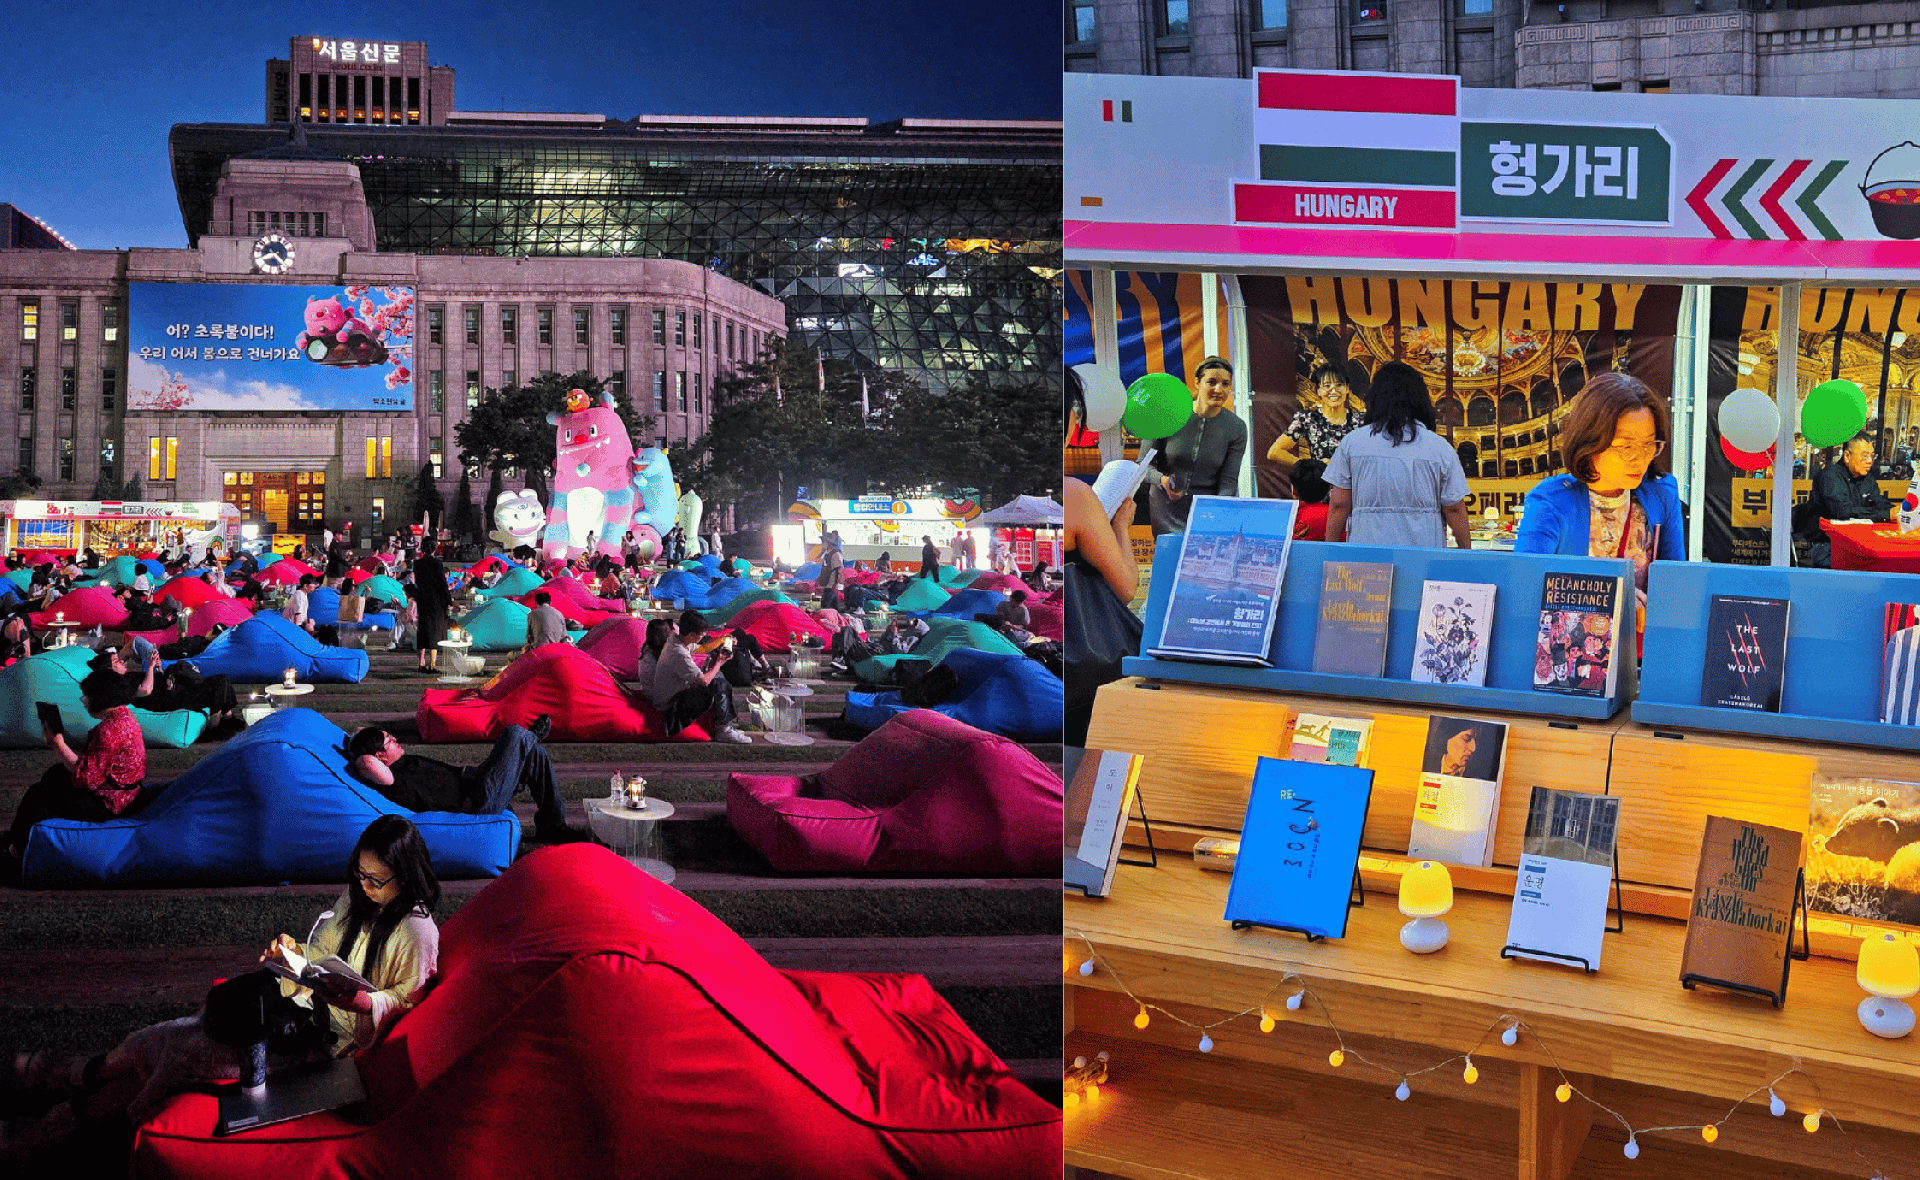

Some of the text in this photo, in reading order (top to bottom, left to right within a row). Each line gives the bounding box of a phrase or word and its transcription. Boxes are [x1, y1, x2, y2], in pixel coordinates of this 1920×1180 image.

[319, 40, 400, 63] 서울신문
[1488, 140, 1639, 200] 헝가리
[1294, 193, 1398, 220] HUNGARY
[1285, 275, 1646, 331] HUNGARY
[166, 323, 275, 340] 어? 초록불이다!
[139, 346, 166, 360] 우리
[170, 347, 198, 360] 어서
[248, 347, 300, 360] 건너가요
[1546, 577, 1612, 593] MELANCHOLY
[1546, 590, 1610, 607] RESISTANCE
[1736, 624, 1759, 635] THE
[1731, 643, 1761, 655] LAST
[1727, 662, 1761, 674] WOLF
